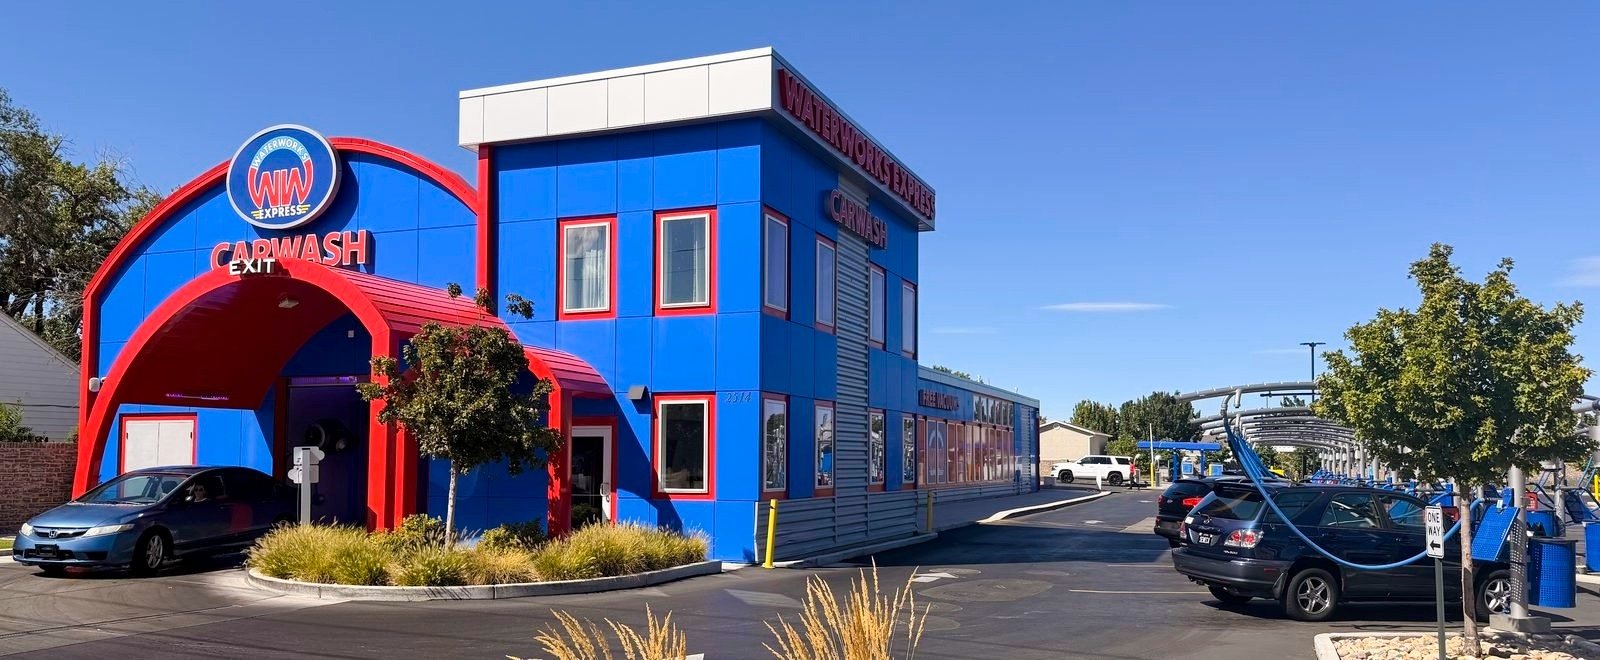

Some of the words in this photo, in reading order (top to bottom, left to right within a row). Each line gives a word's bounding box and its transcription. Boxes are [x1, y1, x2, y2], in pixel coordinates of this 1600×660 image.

[252, 138, 308, 167] WATERWORKS
[779, 69, 891, 185] WATERWORKS
[892, 163, 935, 219] EXPRESS
[258, 205, 302, 219] EXPRESS
[829, 188, 888, 249] CARWASH
[211, 229, 367, 270] CARWASH
[229, 258, 276, 275] EXIT
[922, 390, 936, 407] FREE
[1428, 512, 1440, 523] ONE
[1428, 526, 1441, 537] WAY
